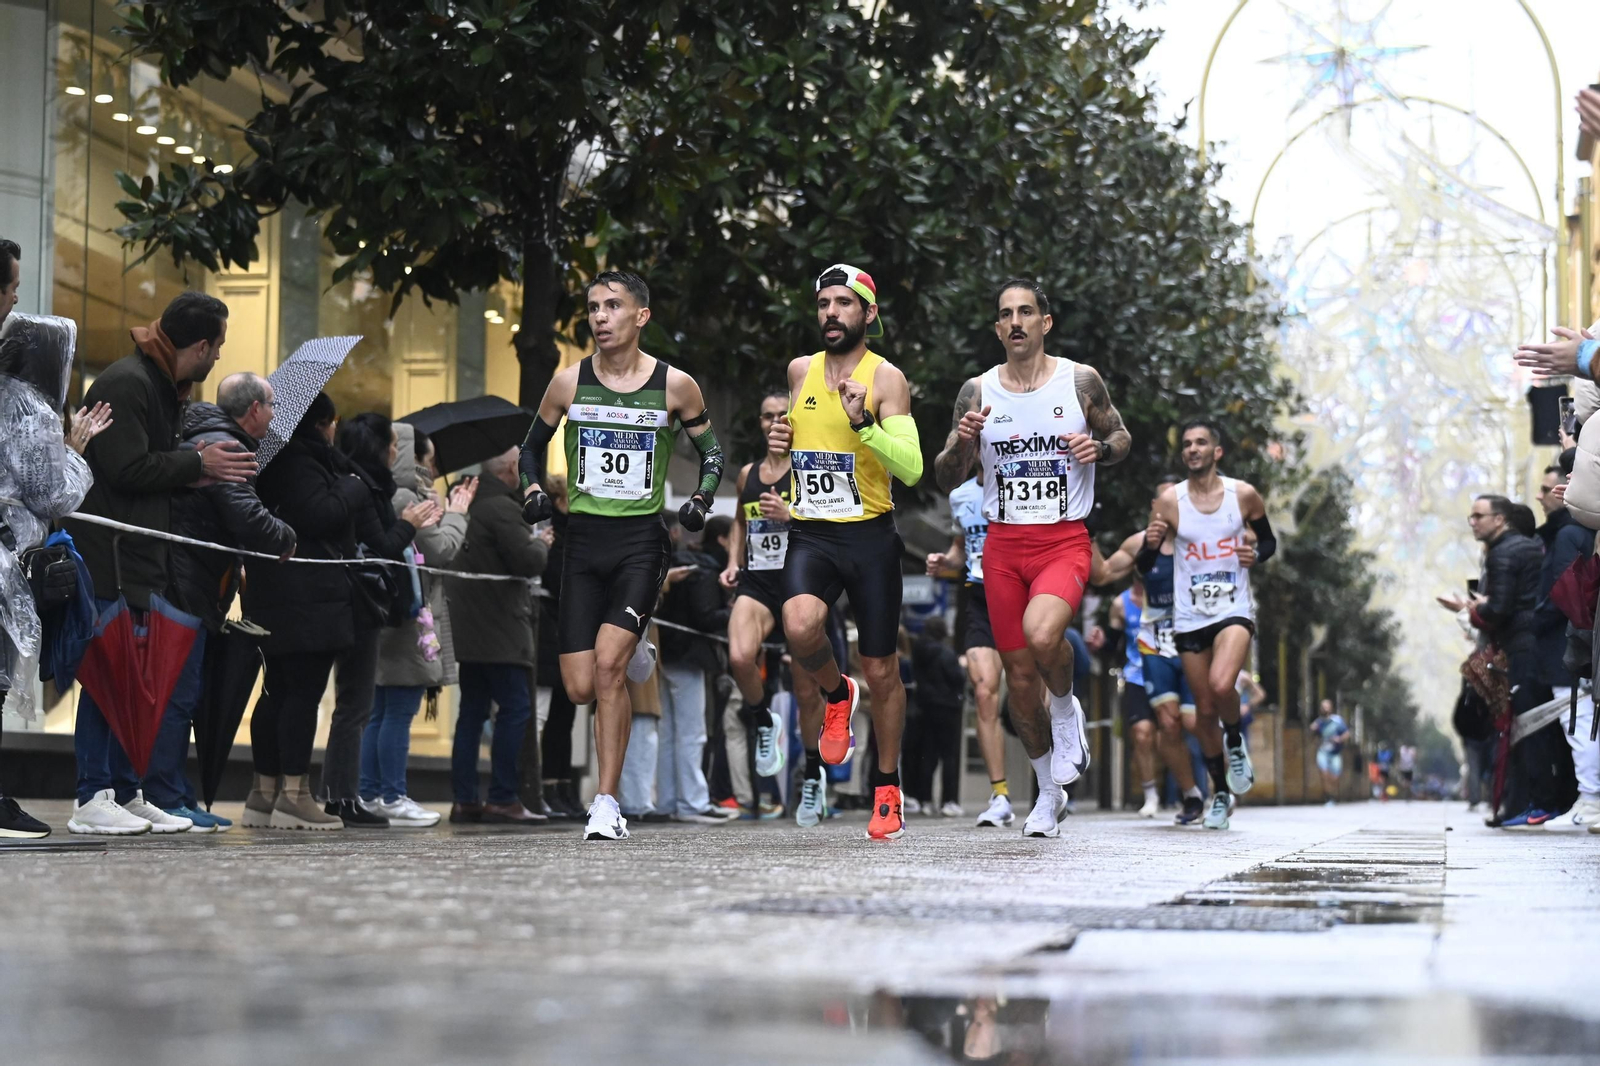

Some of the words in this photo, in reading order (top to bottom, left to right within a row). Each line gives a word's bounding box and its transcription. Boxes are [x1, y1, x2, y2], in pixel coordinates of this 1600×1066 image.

[614, 431, 639, 440] MEDIA
[600, 451, 630, 475] 30
[815, 452, 838, 461] MEDIA
[604, 477, 624, 485] CARLOS
[806, 472, 835, 495] 50
[1005, 480, 1059, 501] 1318
[761, 534, 782, 551] 49
[1202, 584, 1221, 599] 52
